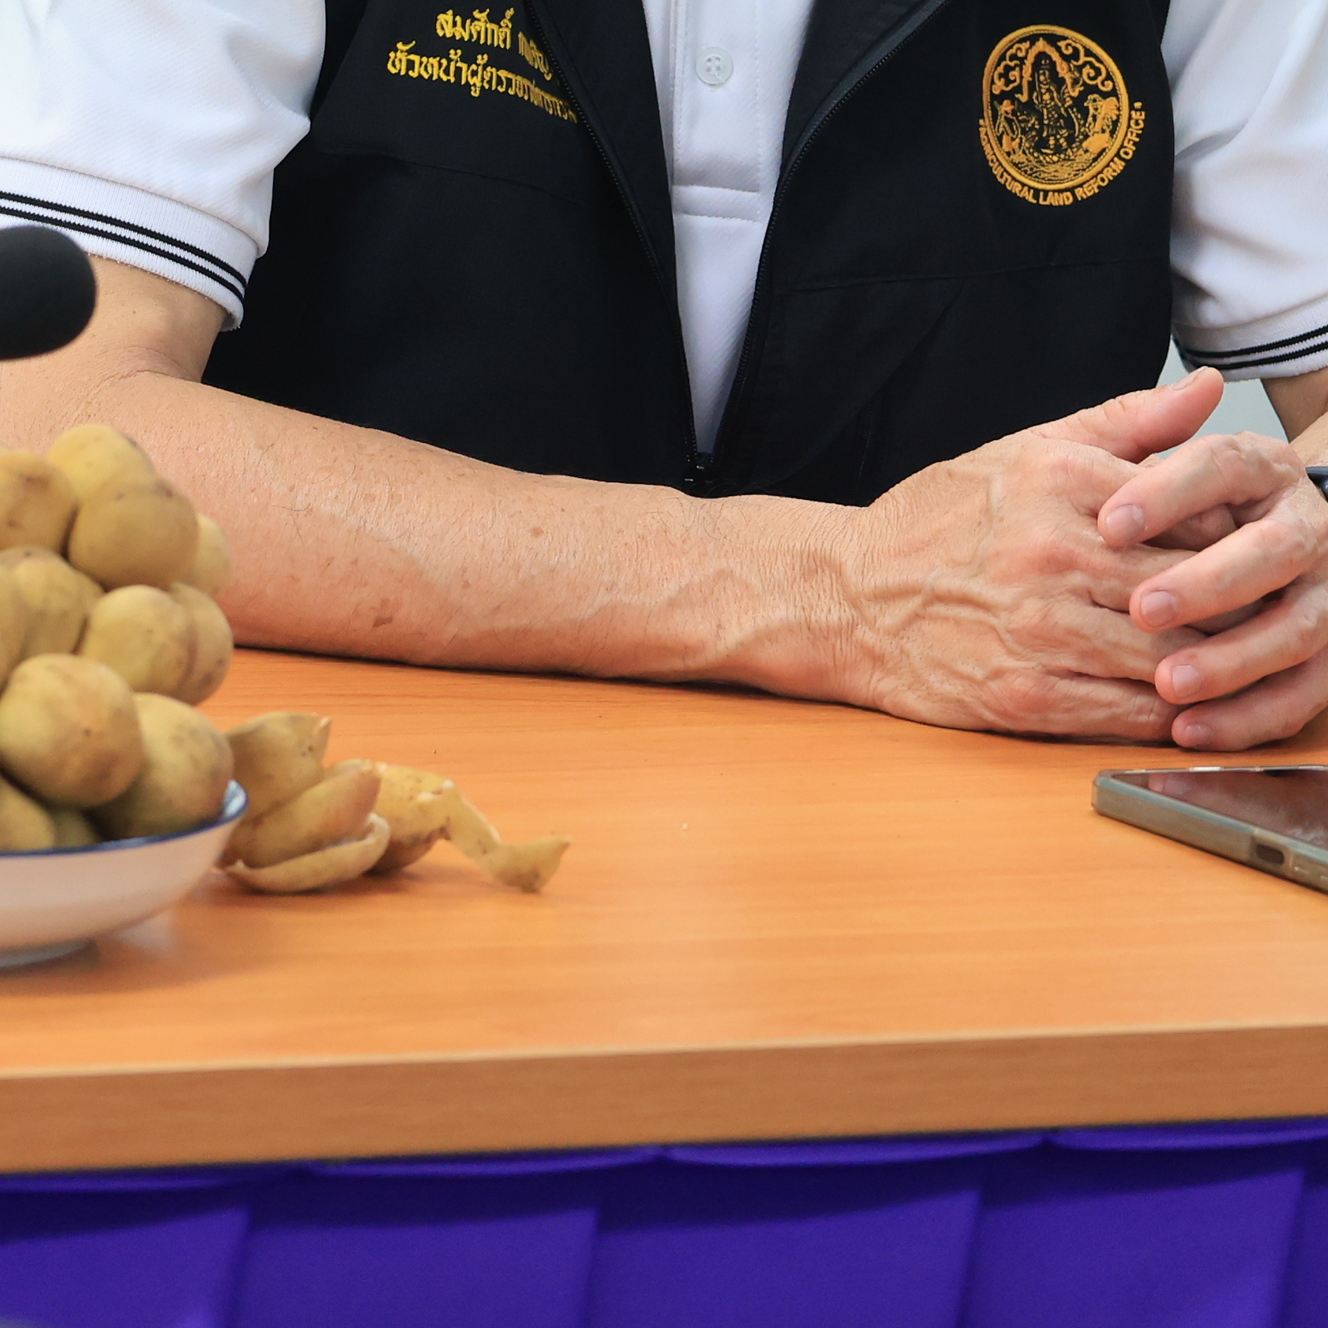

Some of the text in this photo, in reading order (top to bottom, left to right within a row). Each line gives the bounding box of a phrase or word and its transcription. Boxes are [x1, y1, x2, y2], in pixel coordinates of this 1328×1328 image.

[435, 7, 515, 50] สมศักดิ์
[1038, 191, 1073, 206] LAND
[1074, 157, 1126, 202] REFORM
[1119, 110, 1146, 161] OFFICE
